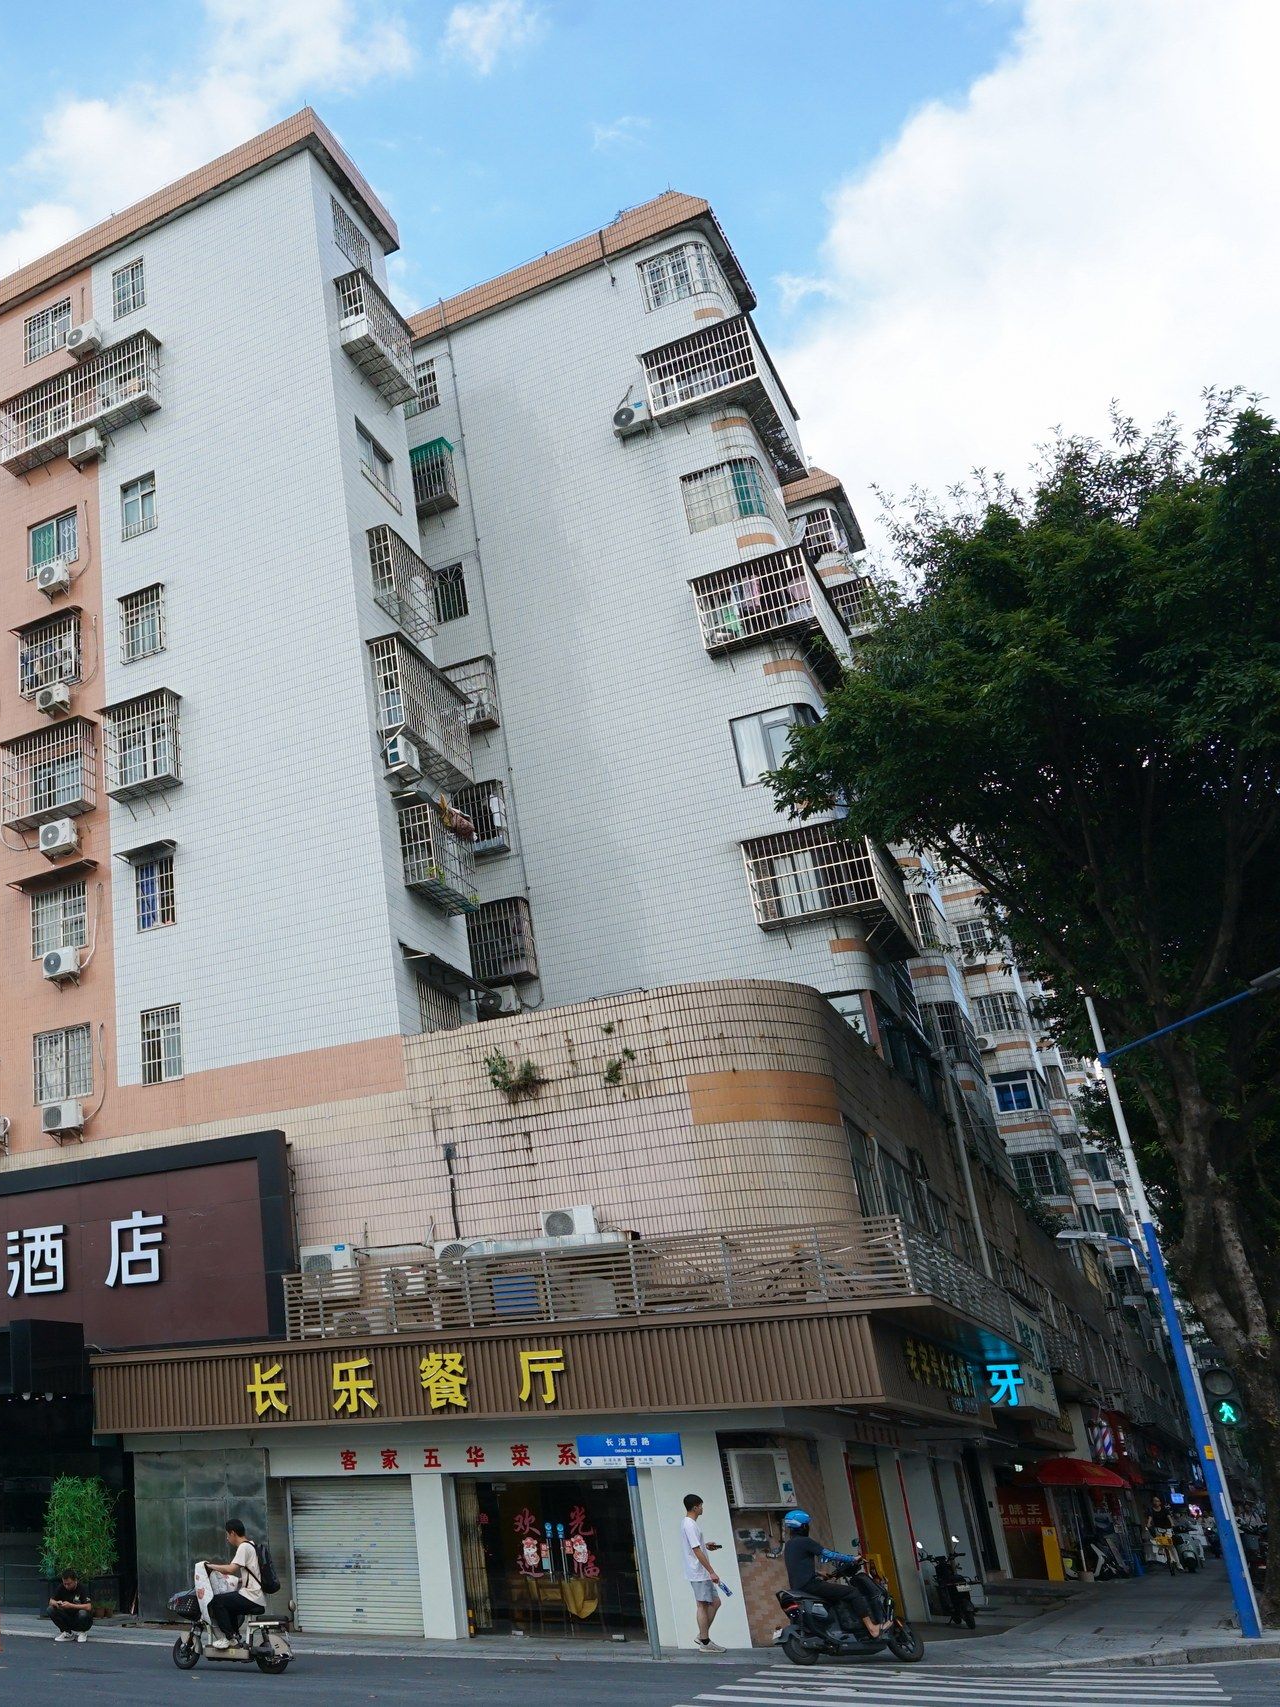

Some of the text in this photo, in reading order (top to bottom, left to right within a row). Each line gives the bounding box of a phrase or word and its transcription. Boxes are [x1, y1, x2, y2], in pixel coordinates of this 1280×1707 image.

[246, 1349, 565, 1416] 长乐餐厅
[986, 1364, 1024, 1406] 牙
[340, 1444, 578, 1471] 客家五华菜系
